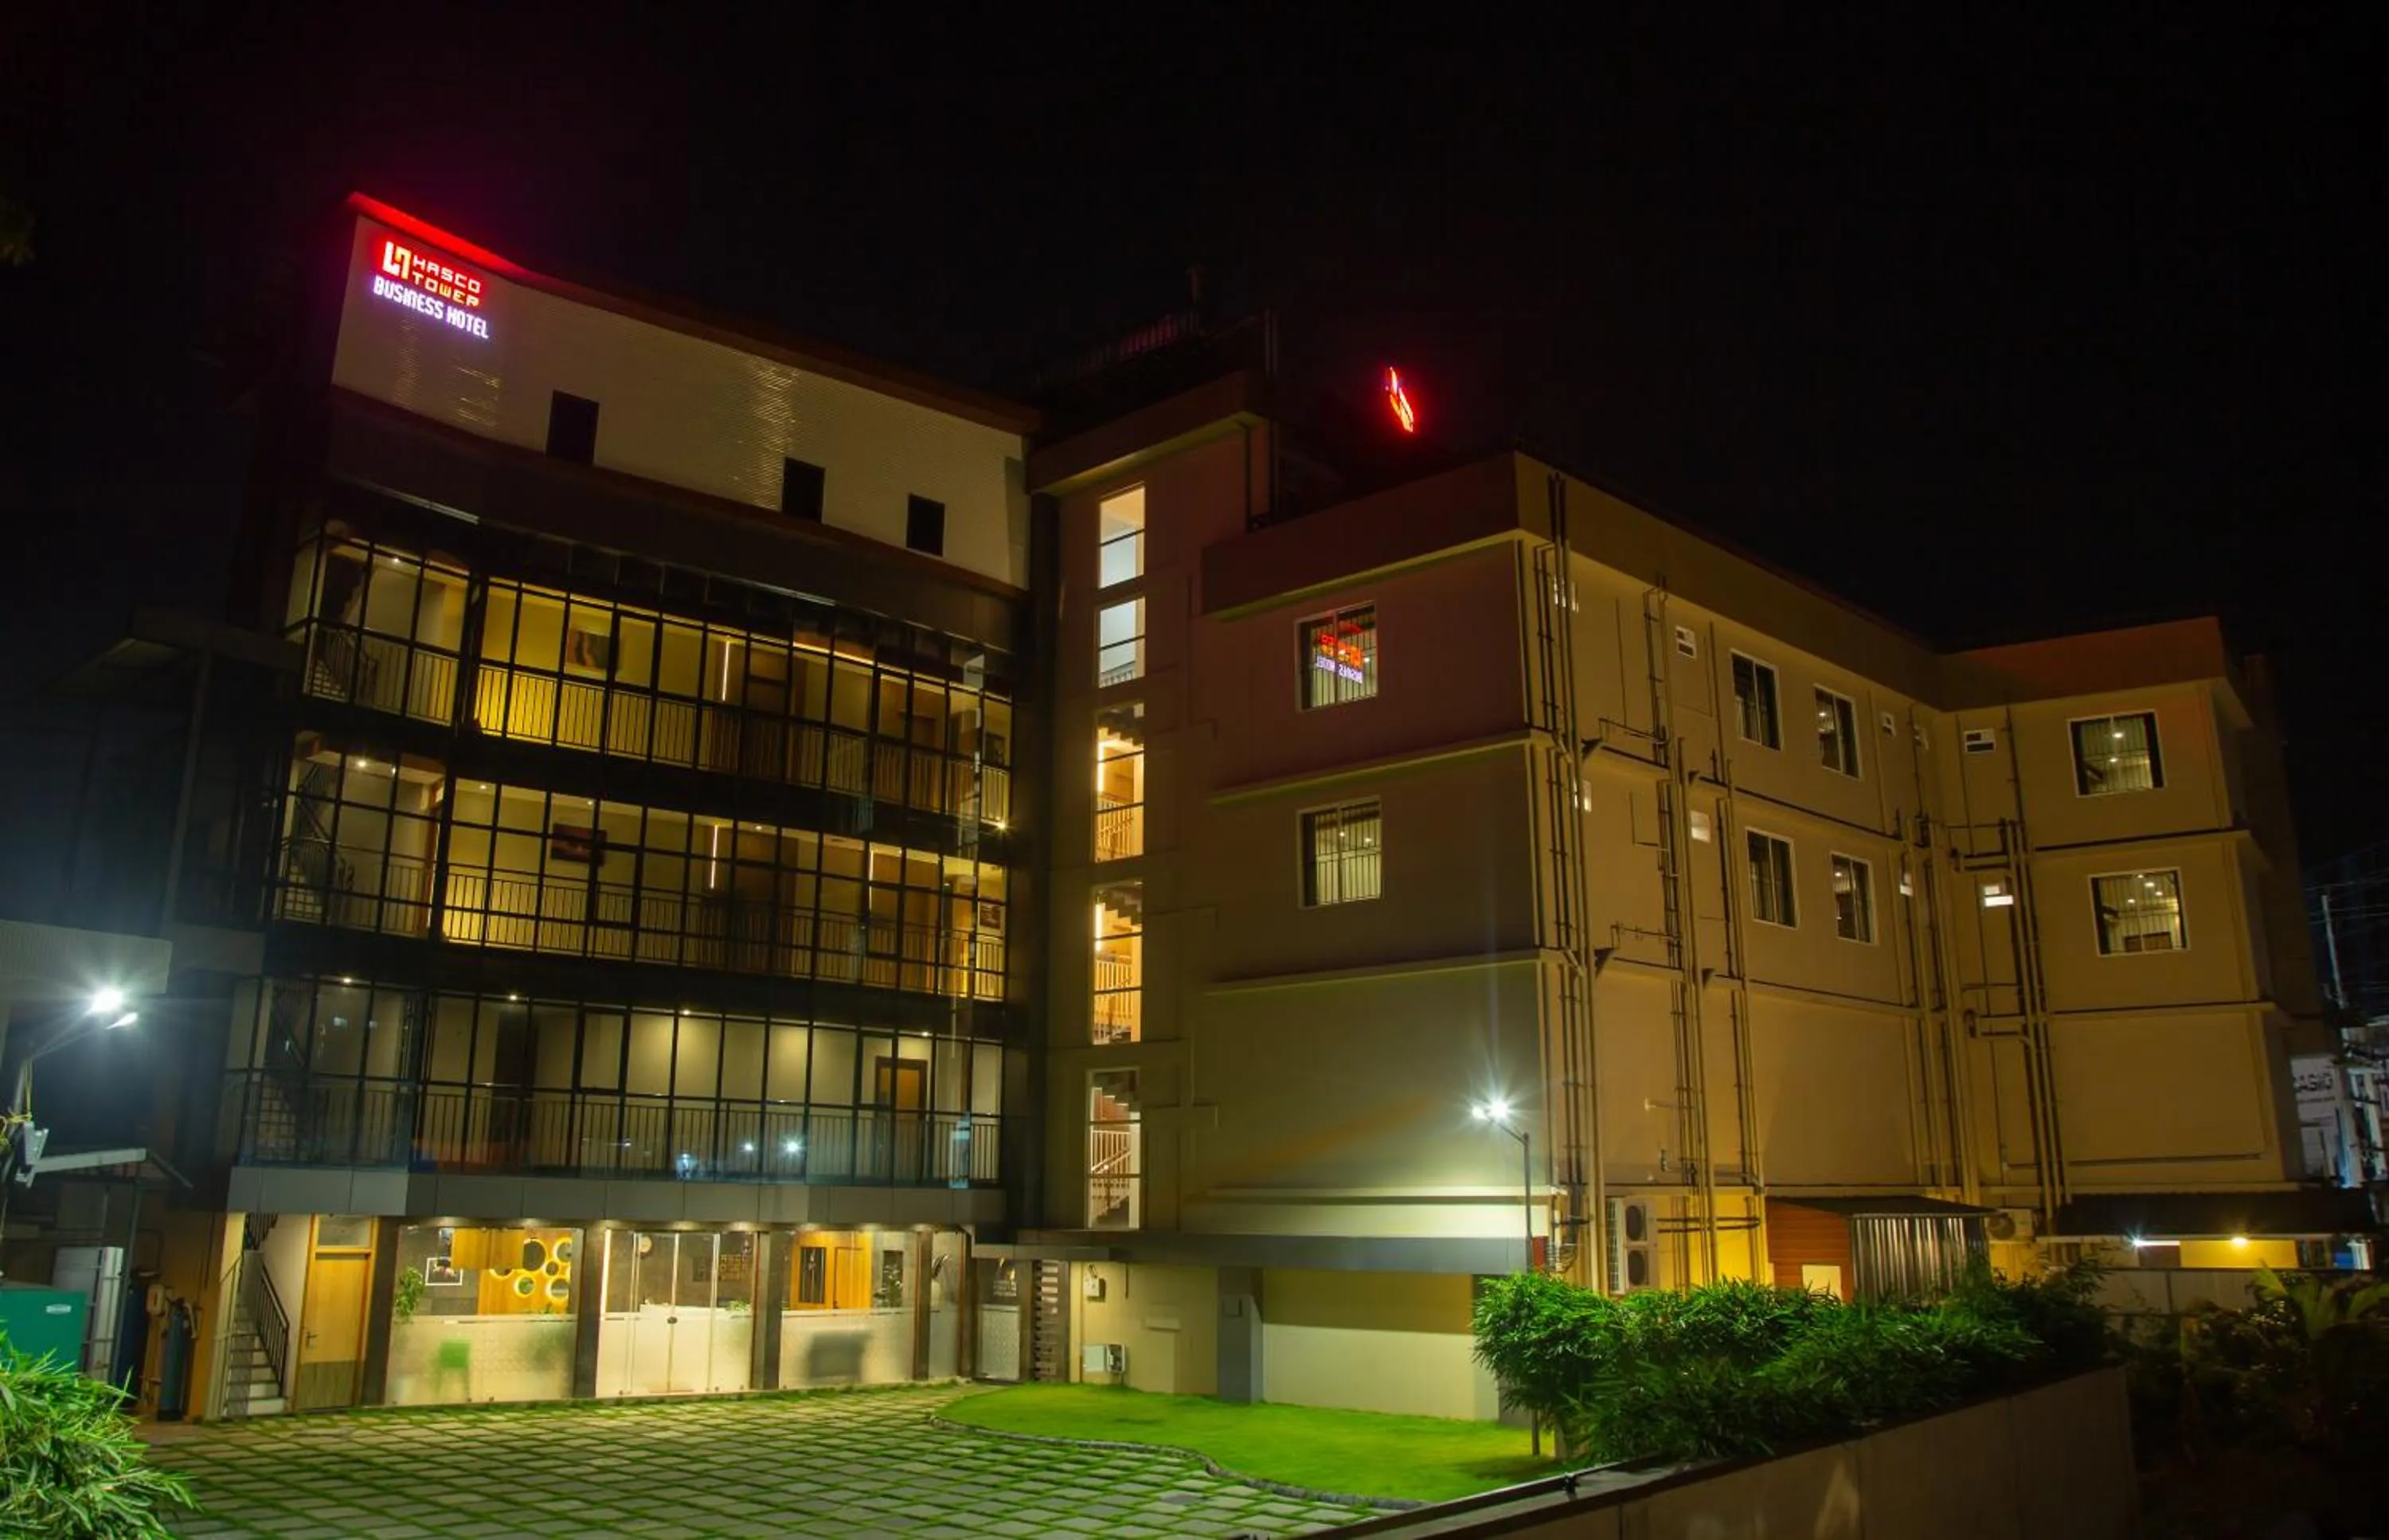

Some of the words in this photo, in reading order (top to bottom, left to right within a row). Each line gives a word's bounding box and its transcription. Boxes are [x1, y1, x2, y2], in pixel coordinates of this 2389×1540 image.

[413, 254, 481, 294] HASCO
[413, 271, 479, 307] TOWER
[373, 274, 444, 319] BUSINESS
[446, 305, 489, 339] HOTEL
